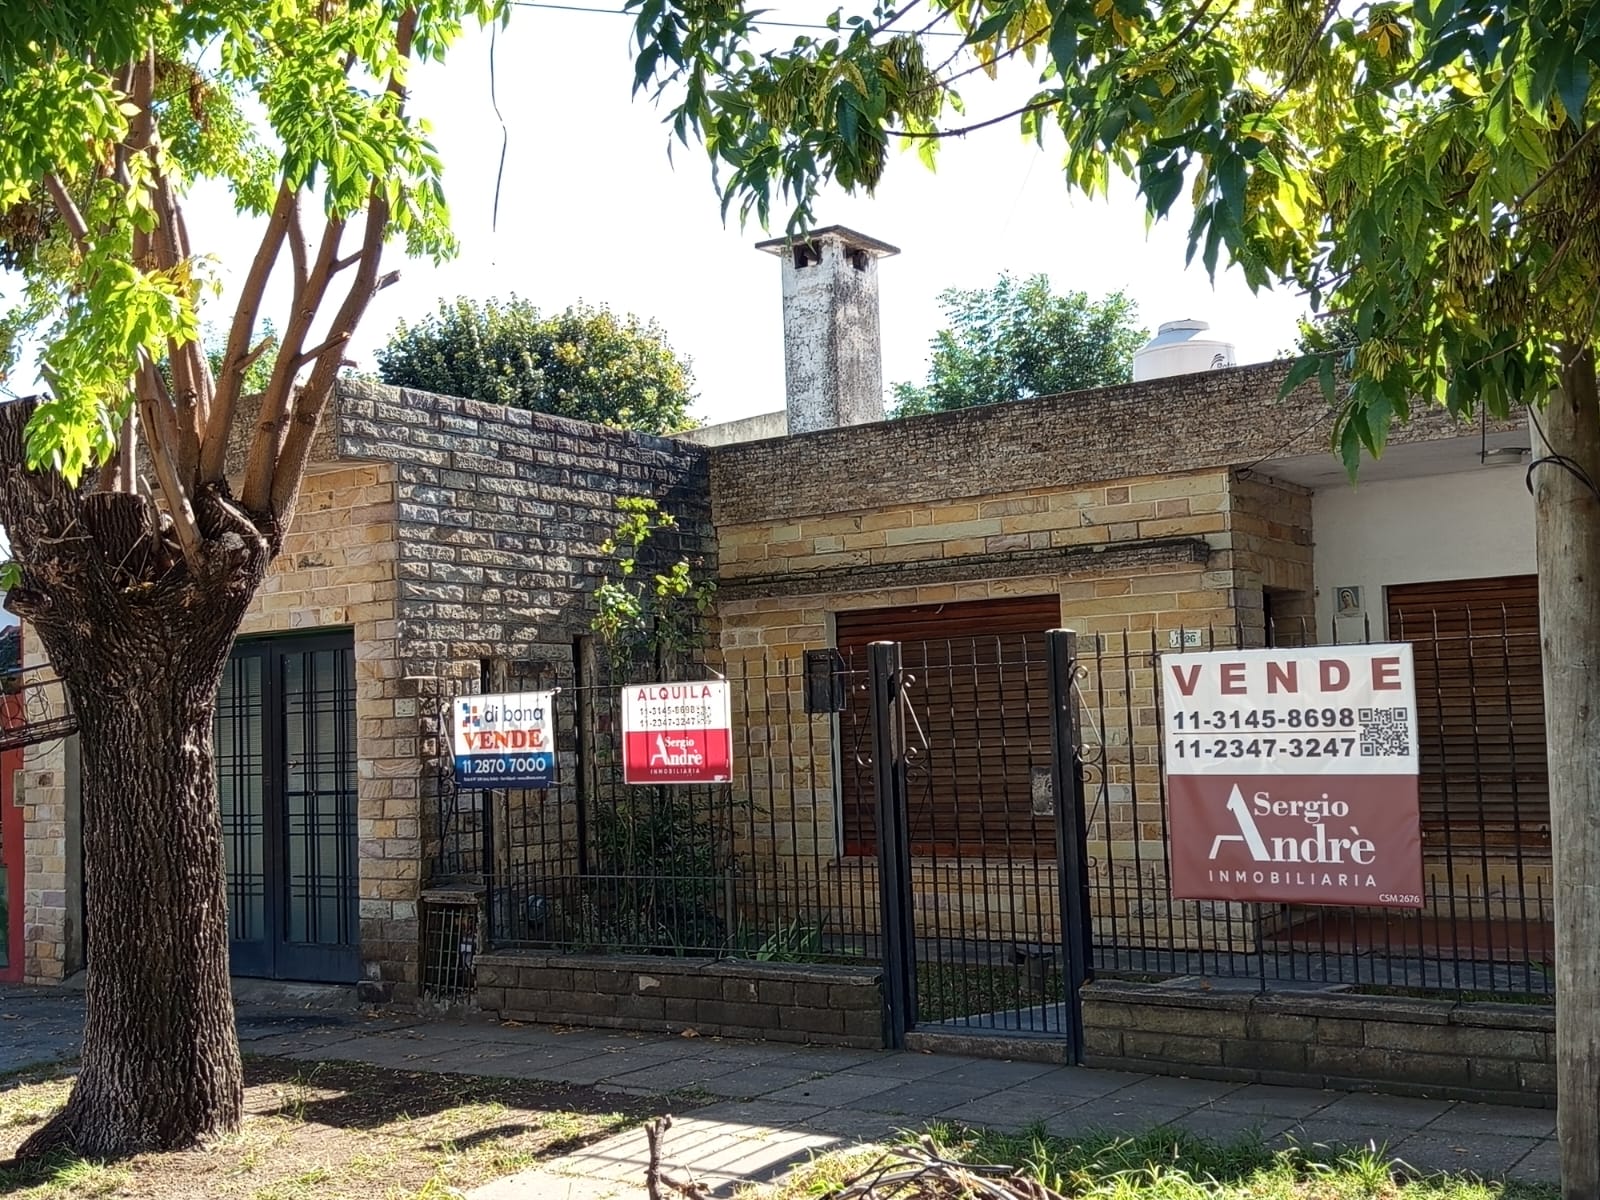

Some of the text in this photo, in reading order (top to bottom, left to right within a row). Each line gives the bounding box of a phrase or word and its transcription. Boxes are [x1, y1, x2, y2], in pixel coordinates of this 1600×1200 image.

[1174, 634, 1196, 644] 126
[1171, 656, 1402, 697] VENDE
[637, 685, 712, 702] ALQUILA
[1173, 707, 1355, 730] 11-3145-8698
[463, 728, 544, 751] VENDE
[664, 736, 695, 750] Sergio
[1174, 737, 1356, 758] 11-2347-3247
[463, 757, 546, 774] 11 2870 7000
[650, 768, 700, 776] INMOBILIARIA
[1253, 791, 1349, 824] Sergio
[1209, 869, 1377, 888] INMOBILIARIA
[1378, 893, 1420, 904] CSM 2676
